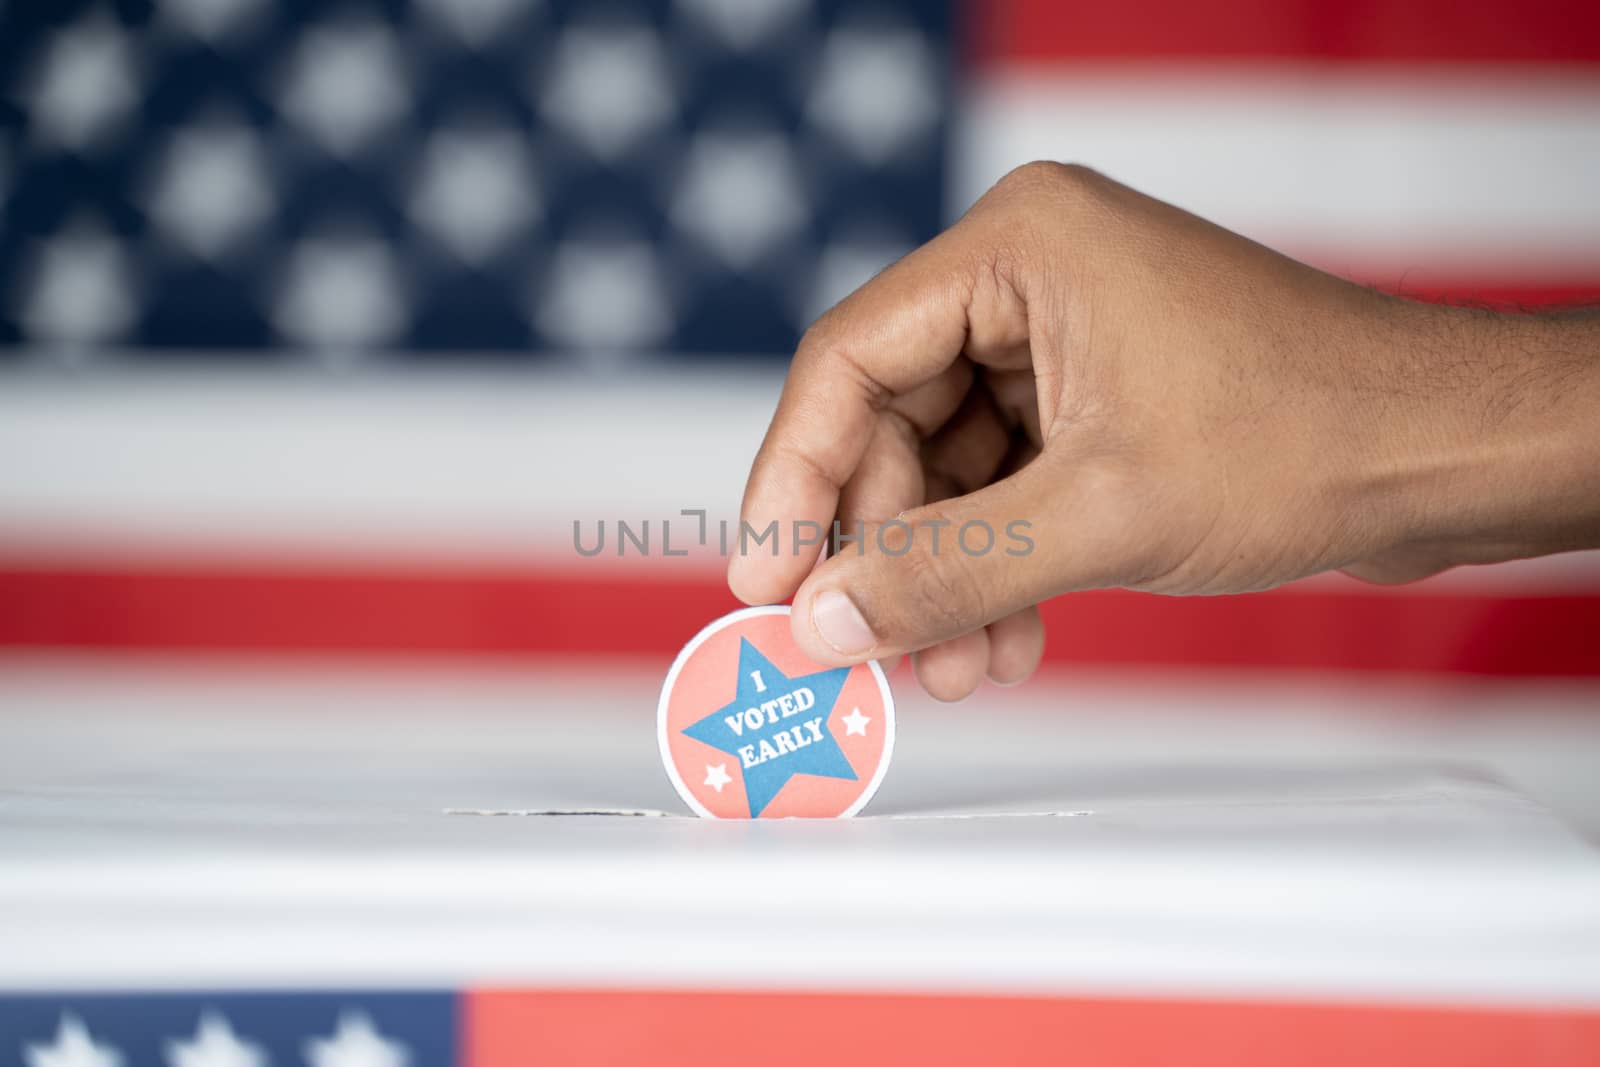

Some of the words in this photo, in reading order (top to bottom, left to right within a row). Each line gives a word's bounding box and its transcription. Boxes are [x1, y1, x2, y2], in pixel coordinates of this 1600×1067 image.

[750, 670, 767, 693] I
[724, 687, 815, 736] VOTED
[738, 717, 824, 769] EARLY
